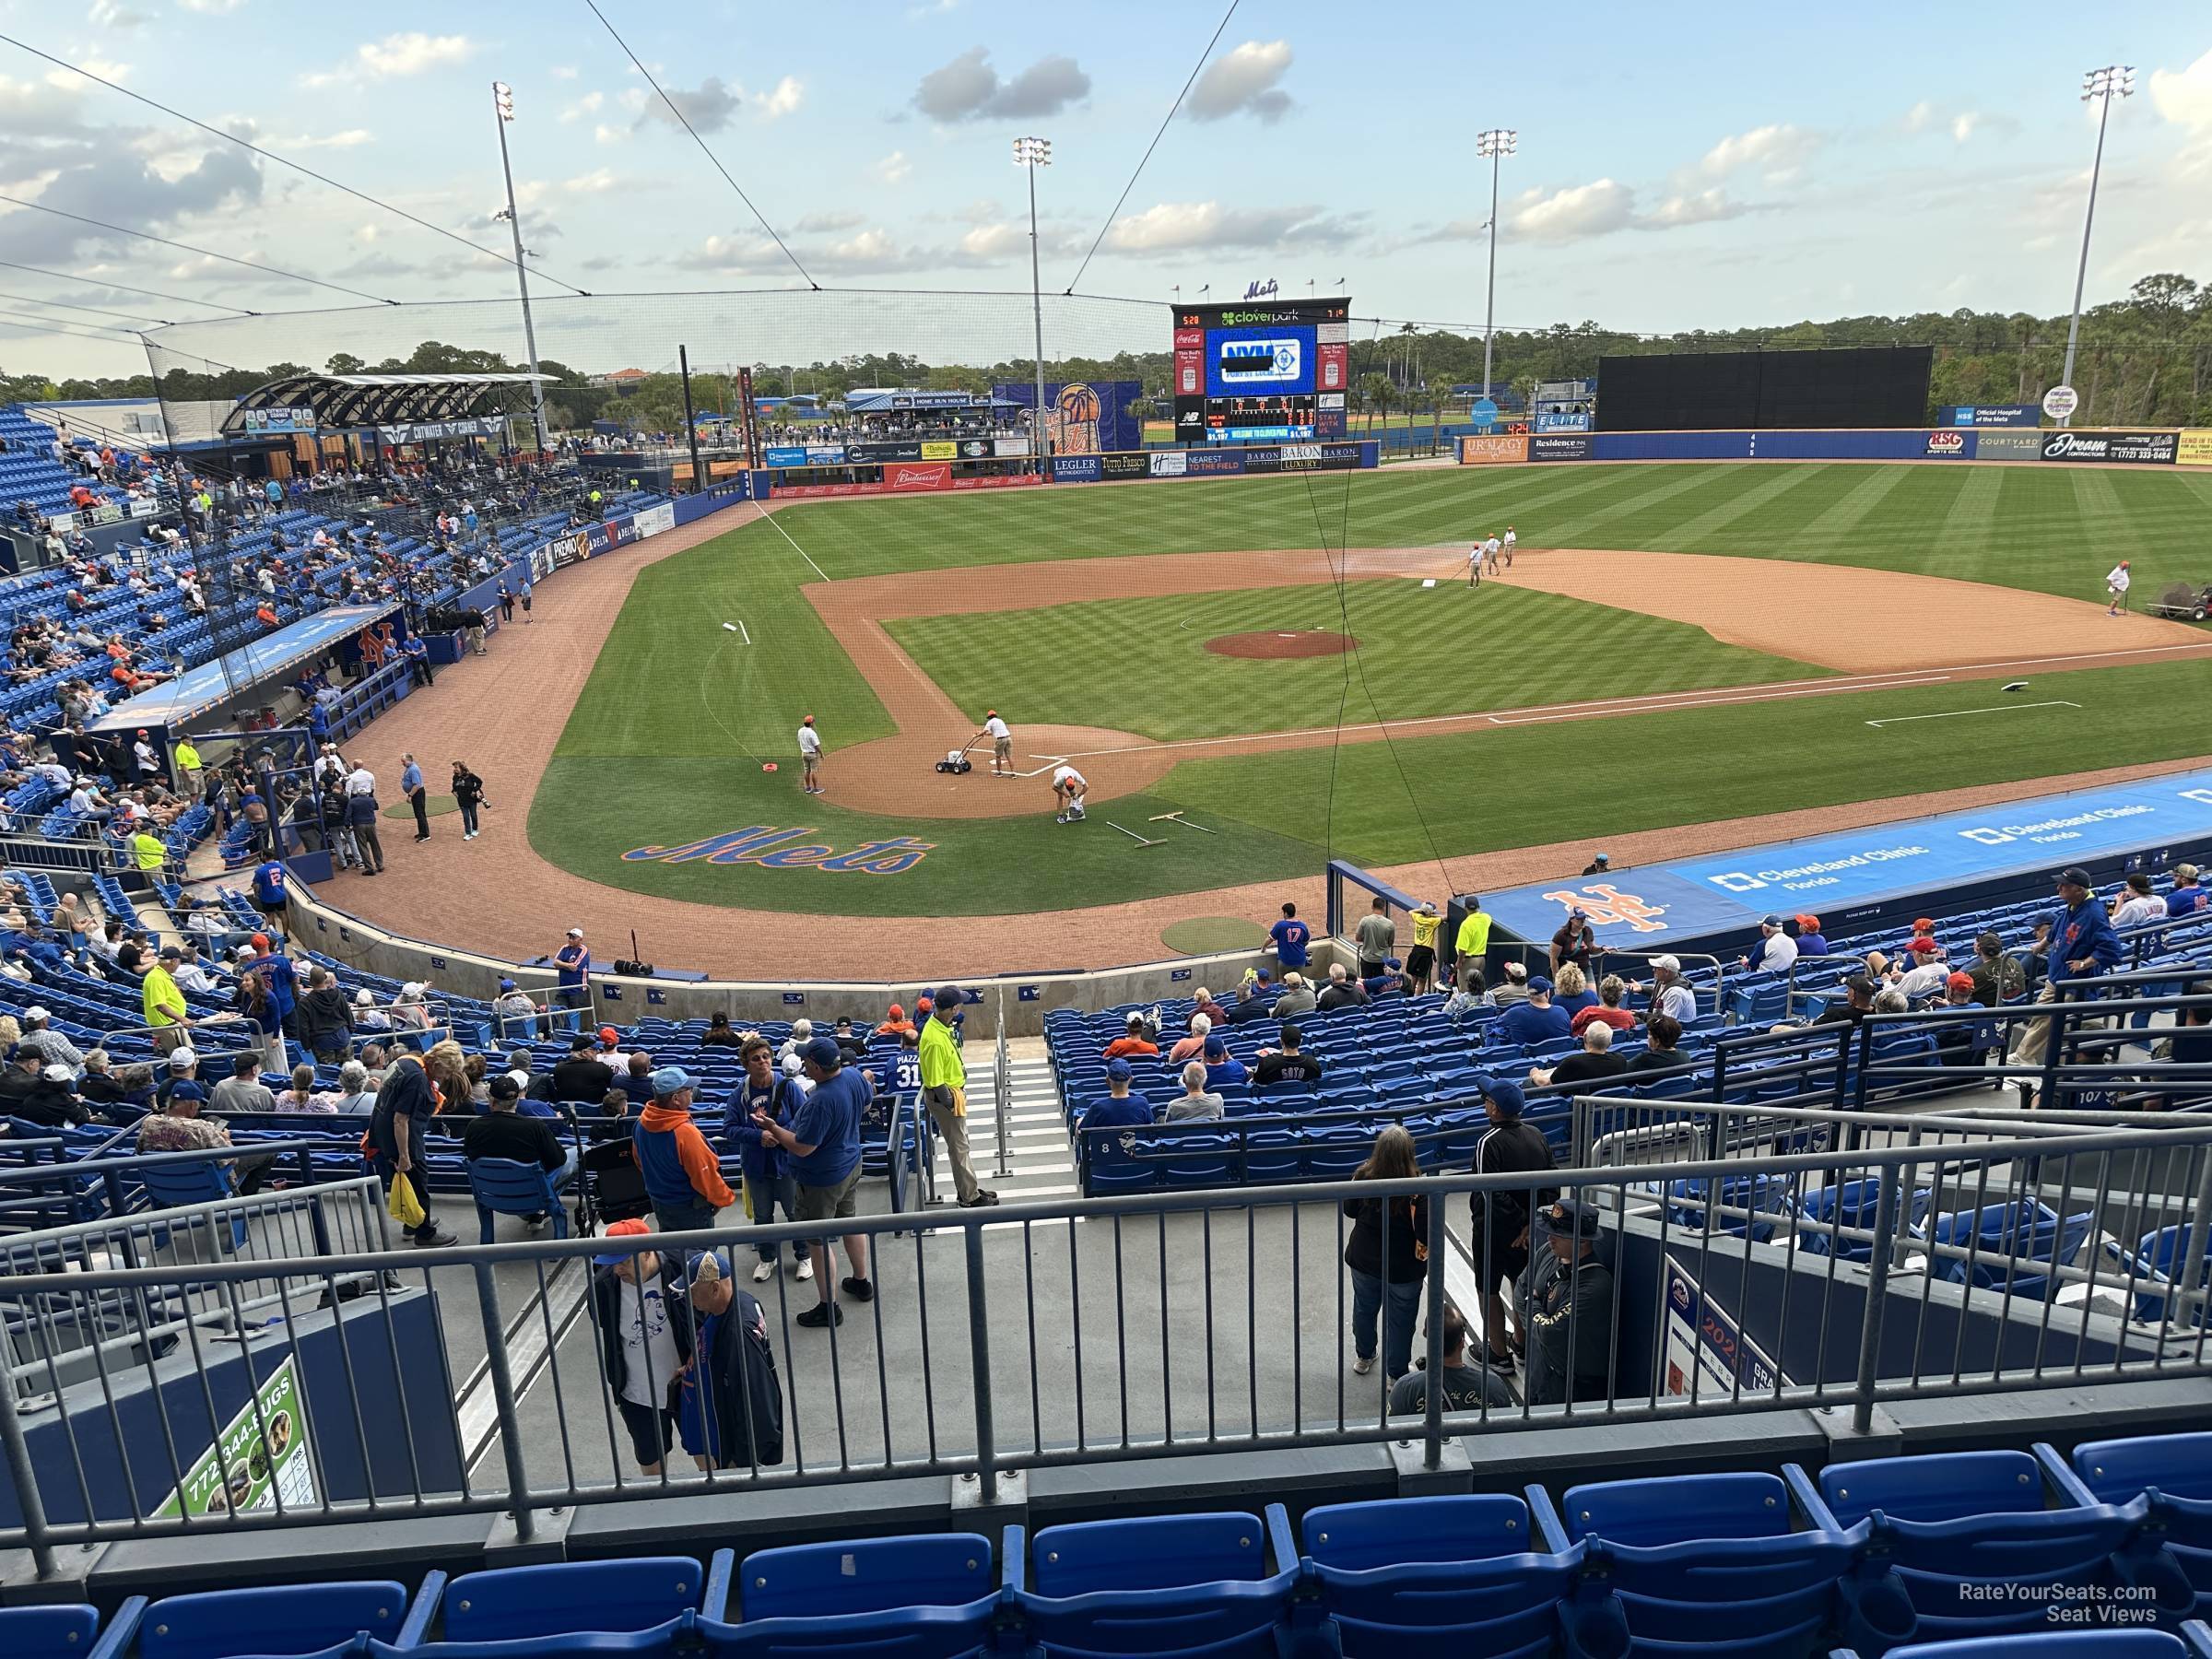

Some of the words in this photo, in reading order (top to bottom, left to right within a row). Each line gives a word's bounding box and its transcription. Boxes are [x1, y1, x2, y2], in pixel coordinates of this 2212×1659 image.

[1243, 278, 1279, 300] Mets
[1183, 316, 1200, 325] 5:28
[1538, 415, 1585, 426] ELITE
[414, 424, 442, 439] CUTWATER
[458, 421, 477, 433] CORNER
[1509, 424, 1528, 435] 4:24
[1535, 439, 1575, 448] Residence
[1930, 430, 1962, 445] RSG
[2044, 433, 2108, 456] Dream
[1246, 452, 1279, 461] BARON
[1281, 445, 1321, 459] BARON
[1323, 448, 1355, 457] BARON
[1055, 459, 1097, 470] LEGLER
[1123, 455, 1146, 467] FRESCO
[1189, 455, 1222, 464] NEAREST
[1285, 460, 1317, 468] LUXURY
[900, 473, 941, 483] Budweiser
[620, 525, 636, 538] DELTA
[554, 537, 577, 559] PREMIO
[592, 535, 608, 549] DELTA
[2002, 813, 2102, 835] Cleveland
[2095, 805, 2156, 819] Clinic
[2030, 831, 2082, 843] Florida
[620, 826, 936, 874] Mets
[1757, 855, 1870, 882] Cleveland
[1863, 845, 1930, 862] Clinic
[1783, 876, 1841, 891] Florida
[1287, 927, 1301, 943] 17
[1981, 1029, 1987, 1038] 8
[897, 1066, 921, 1088] 31
[1281, 1066, 1305, 1079] SOTO
[2079, 1090, 2101, 1104] 107
[1101, 1143, 1110, 1153] 8
